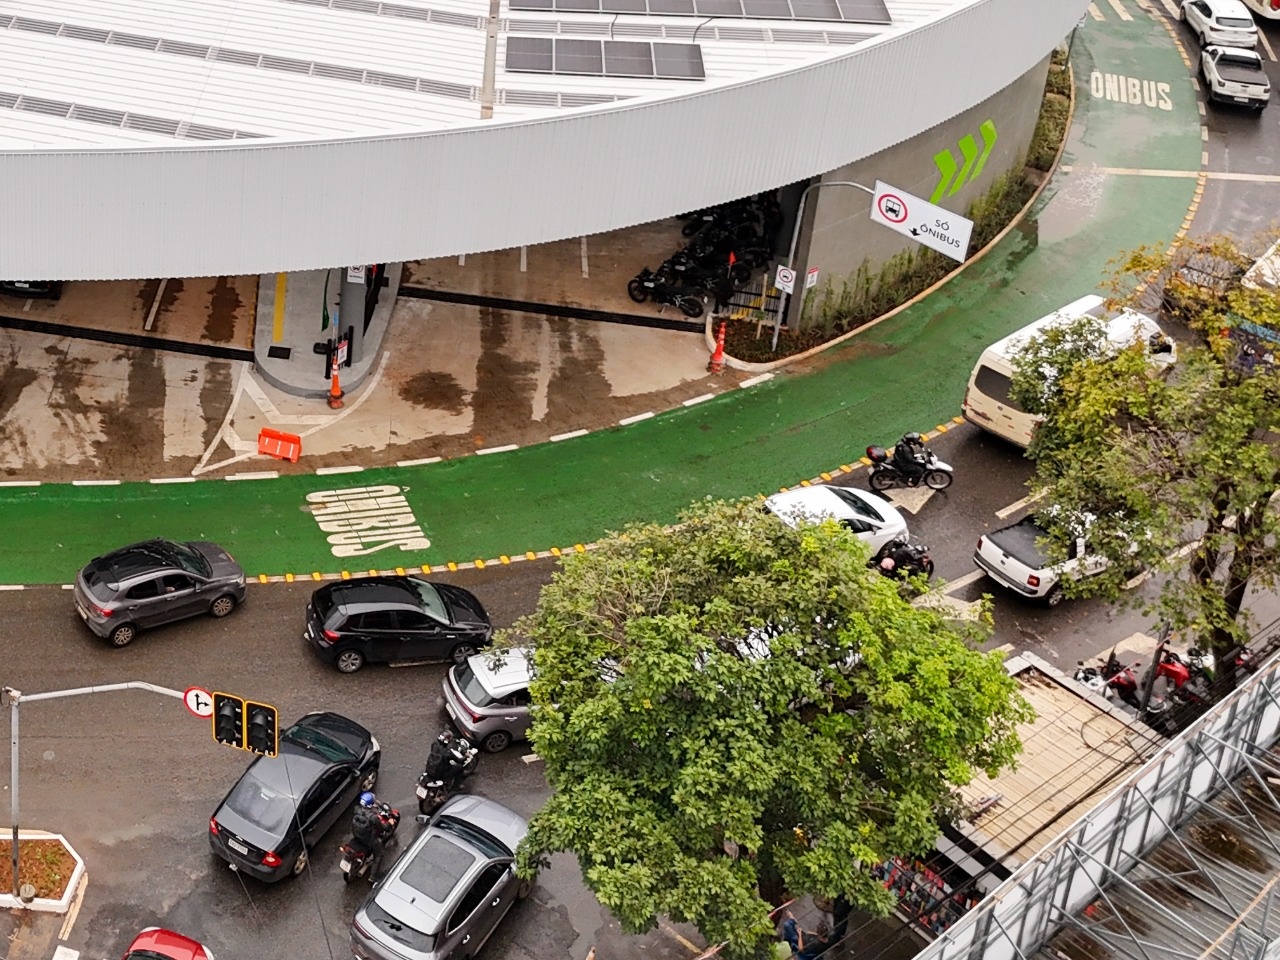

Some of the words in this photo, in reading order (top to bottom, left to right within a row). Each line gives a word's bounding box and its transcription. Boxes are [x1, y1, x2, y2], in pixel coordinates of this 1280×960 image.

[1091, 69, 1172, 111] ÔNIBUS
[920, 223, 961, 248] ÔNIBUS
[934, 219, 950, 231] SÓ
[306, 484, 430, 558] ÔNIBUS
